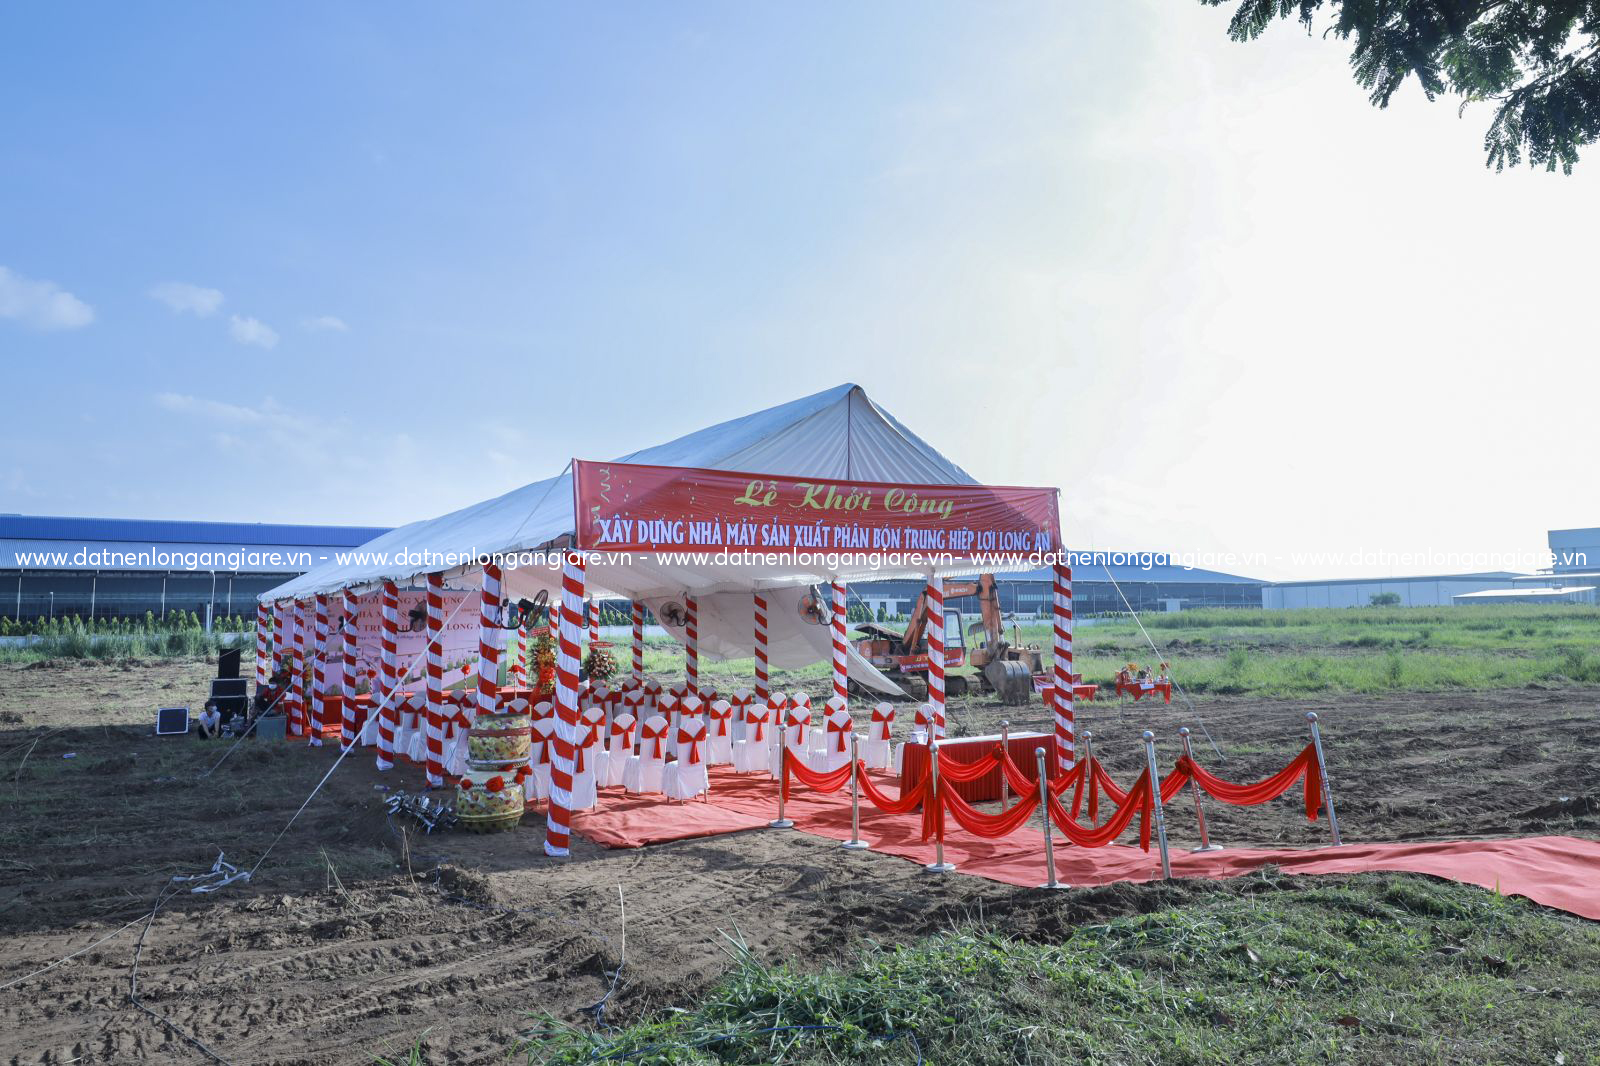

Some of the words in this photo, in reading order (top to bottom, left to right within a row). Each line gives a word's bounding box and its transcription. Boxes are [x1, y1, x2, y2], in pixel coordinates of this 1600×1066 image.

[734, 480, 779, 507] Lễ
[788, 482, 872, 511] Khởi
[884, 488, 954, 520] Công
[599, 514, 634, 543] XÂY
[689, 517, 722, 545] NHÀ
[794, 519, 831, 548] XUẤT
[833, 523, 870, 548] PHÂN
[873, 524, 901, 549] BÓN
[904, 528, 945, 550] TRUNG
[949, 527, 975, 554] HIỆP
[977, 529, 996, 554] LỢI
[999, 531, 1031, 551] LONG
[1034, 531, 1051, 551] AN
